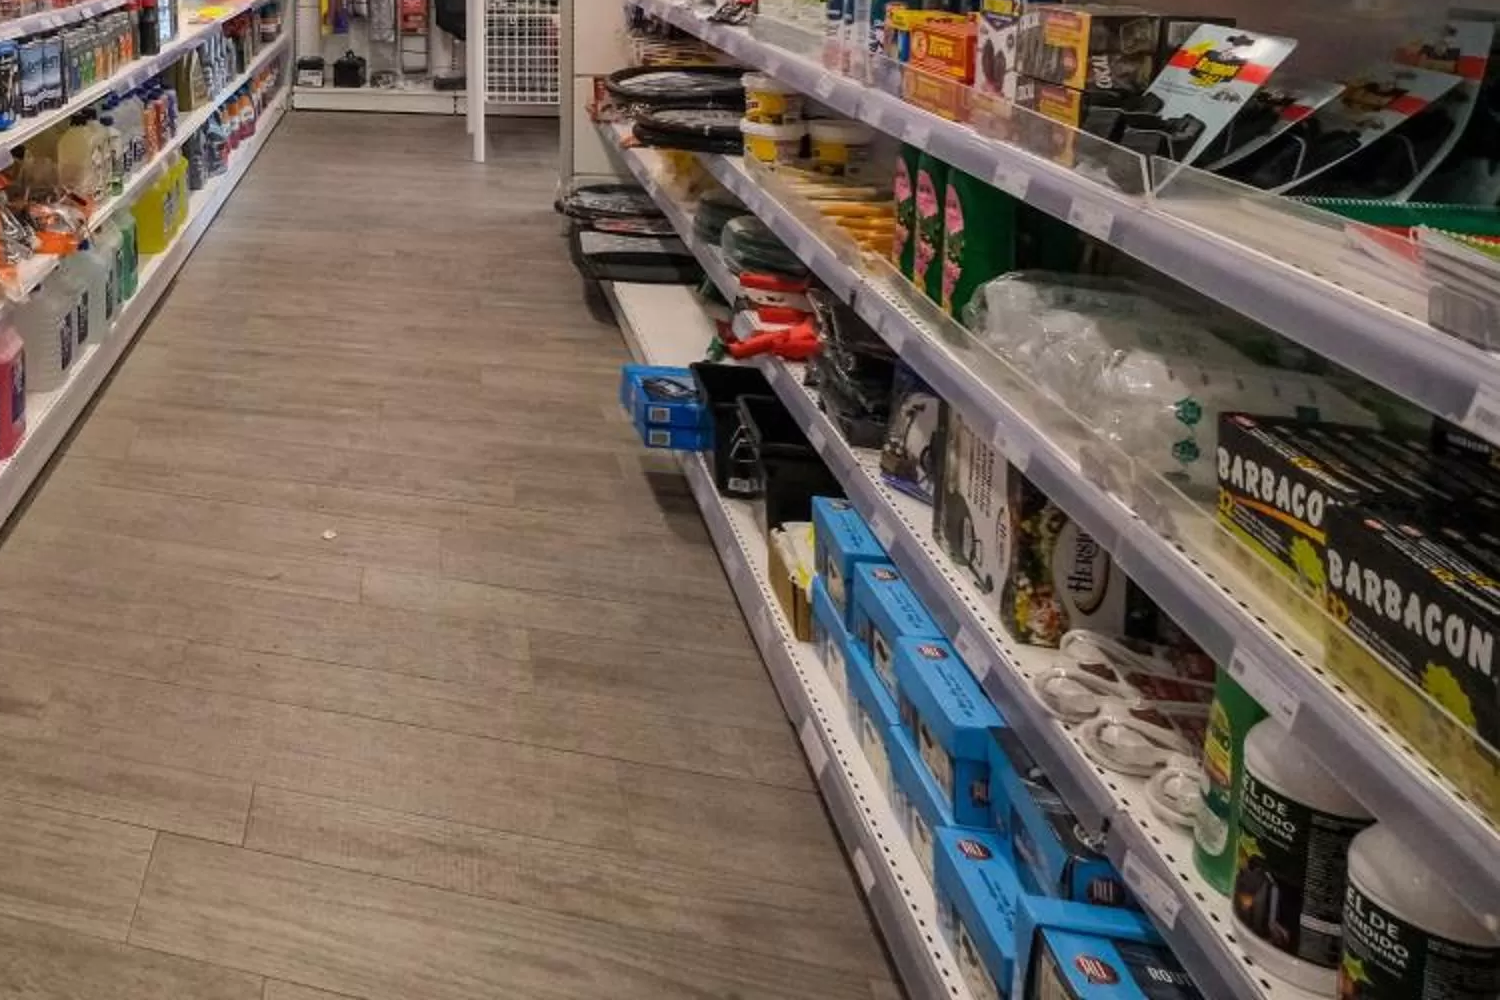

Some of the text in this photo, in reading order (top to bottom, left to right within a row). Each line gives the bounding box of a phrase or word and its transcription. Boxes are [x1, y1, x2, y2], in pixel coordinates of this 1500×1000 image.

[1217, 446, 1343, 528] BARBACO
[1327, 548, 1495, 675] BARBACON
[1263, 794, 1290, 817] DE
[1368, 913, 1401, 942] DE
